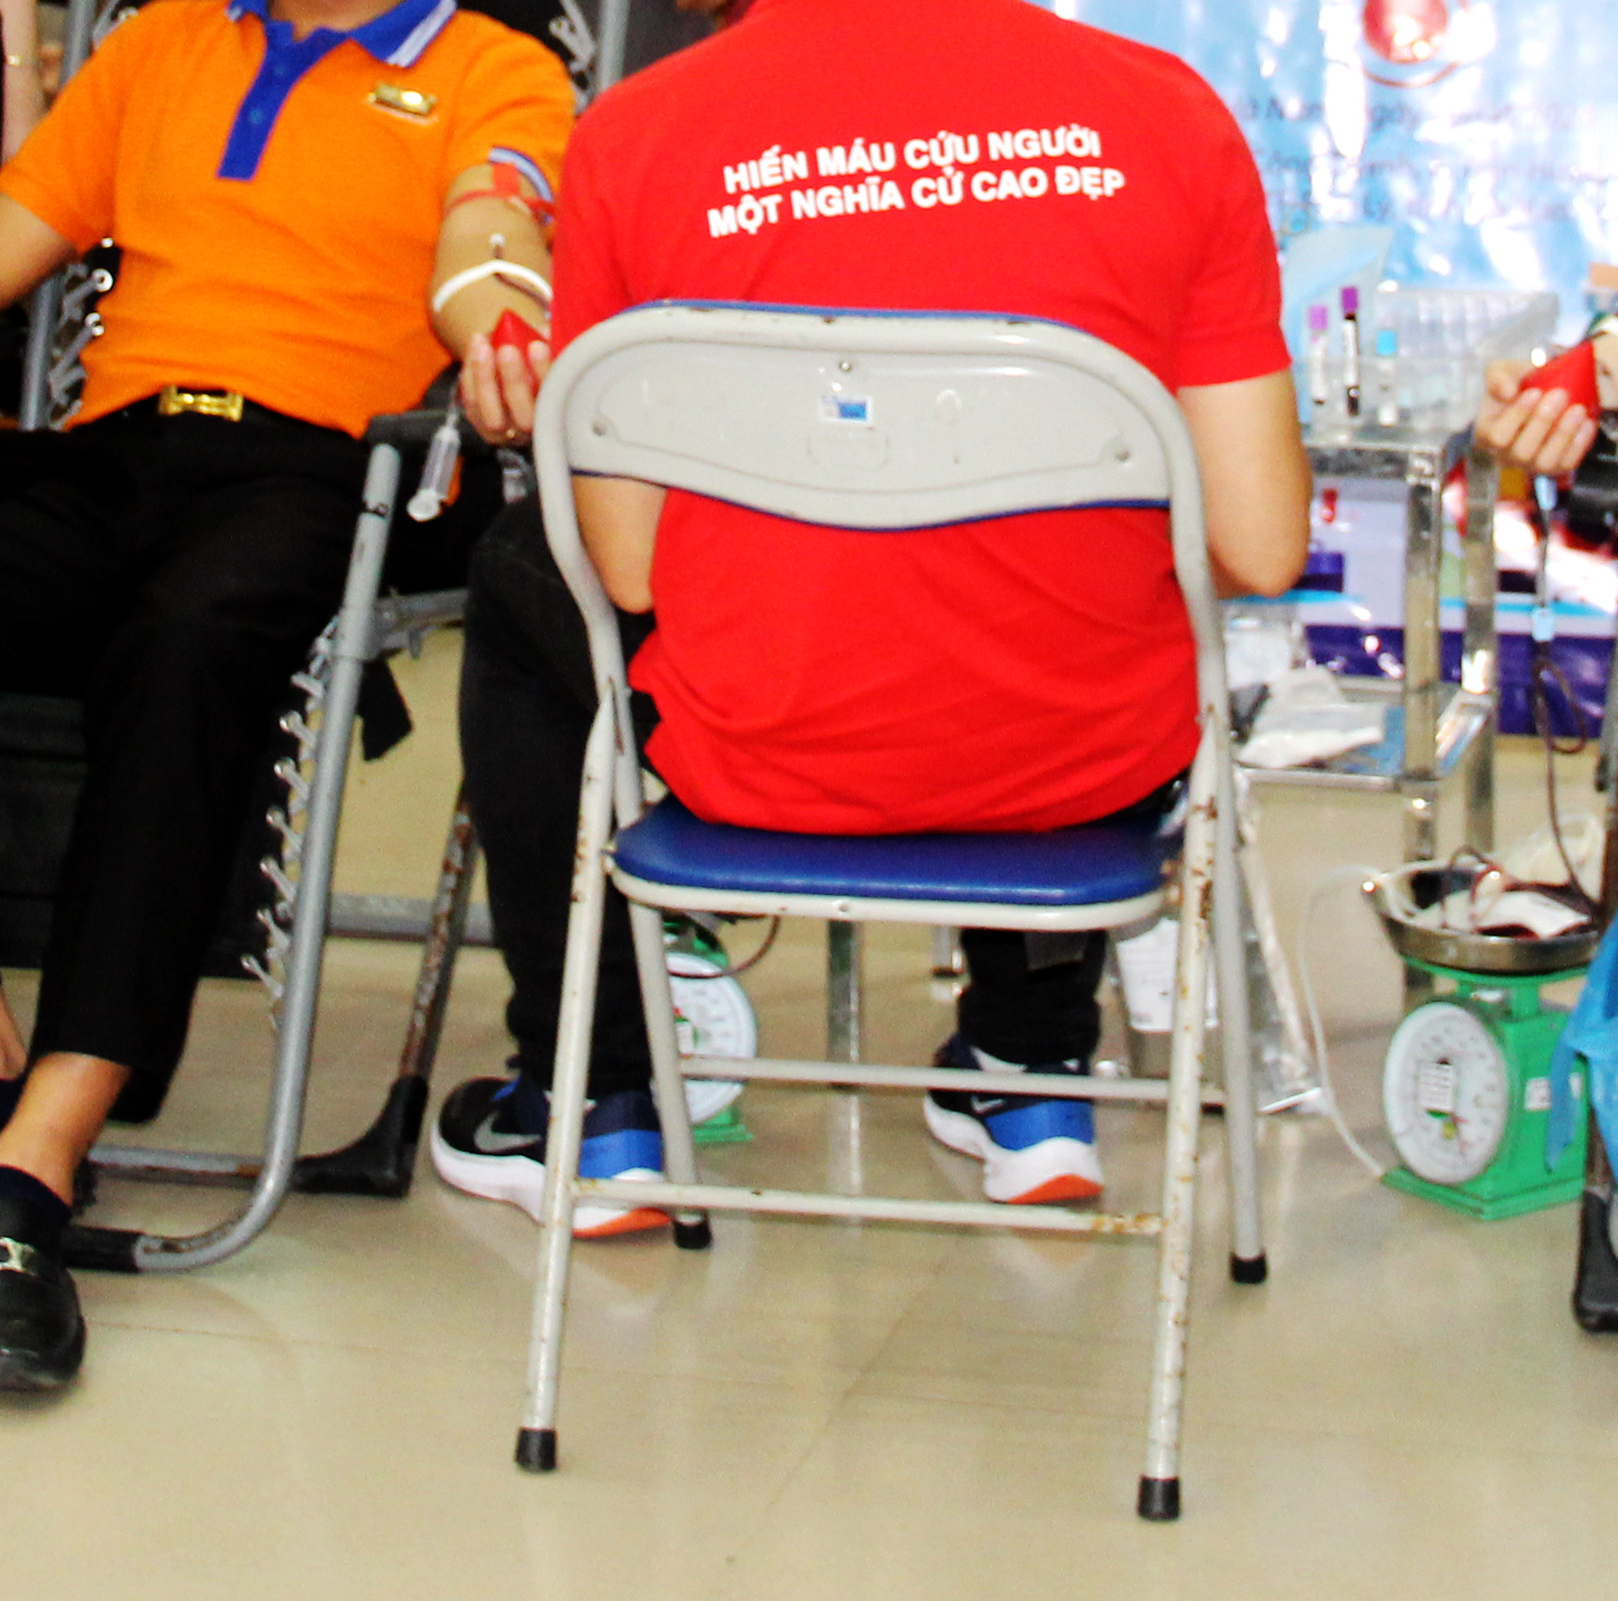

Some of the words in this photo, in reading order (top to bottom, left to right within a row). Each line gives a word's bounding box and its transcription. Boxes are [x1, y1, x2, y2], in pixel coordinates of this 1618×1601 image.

[722, 144, 810, 195] HIẾN
[815, 137, 897, 178] MÁU
[903, 129, 981, 170] CỨU
[986, 122, 1102, 161] NGƯỜI
[706, 193, 784, 238] MỘT
[790, 175, 906, 220] NGHĨA
[970, 166, 1049, 203] CAO
[1054, 164, 1126, 202] ĐẸP
